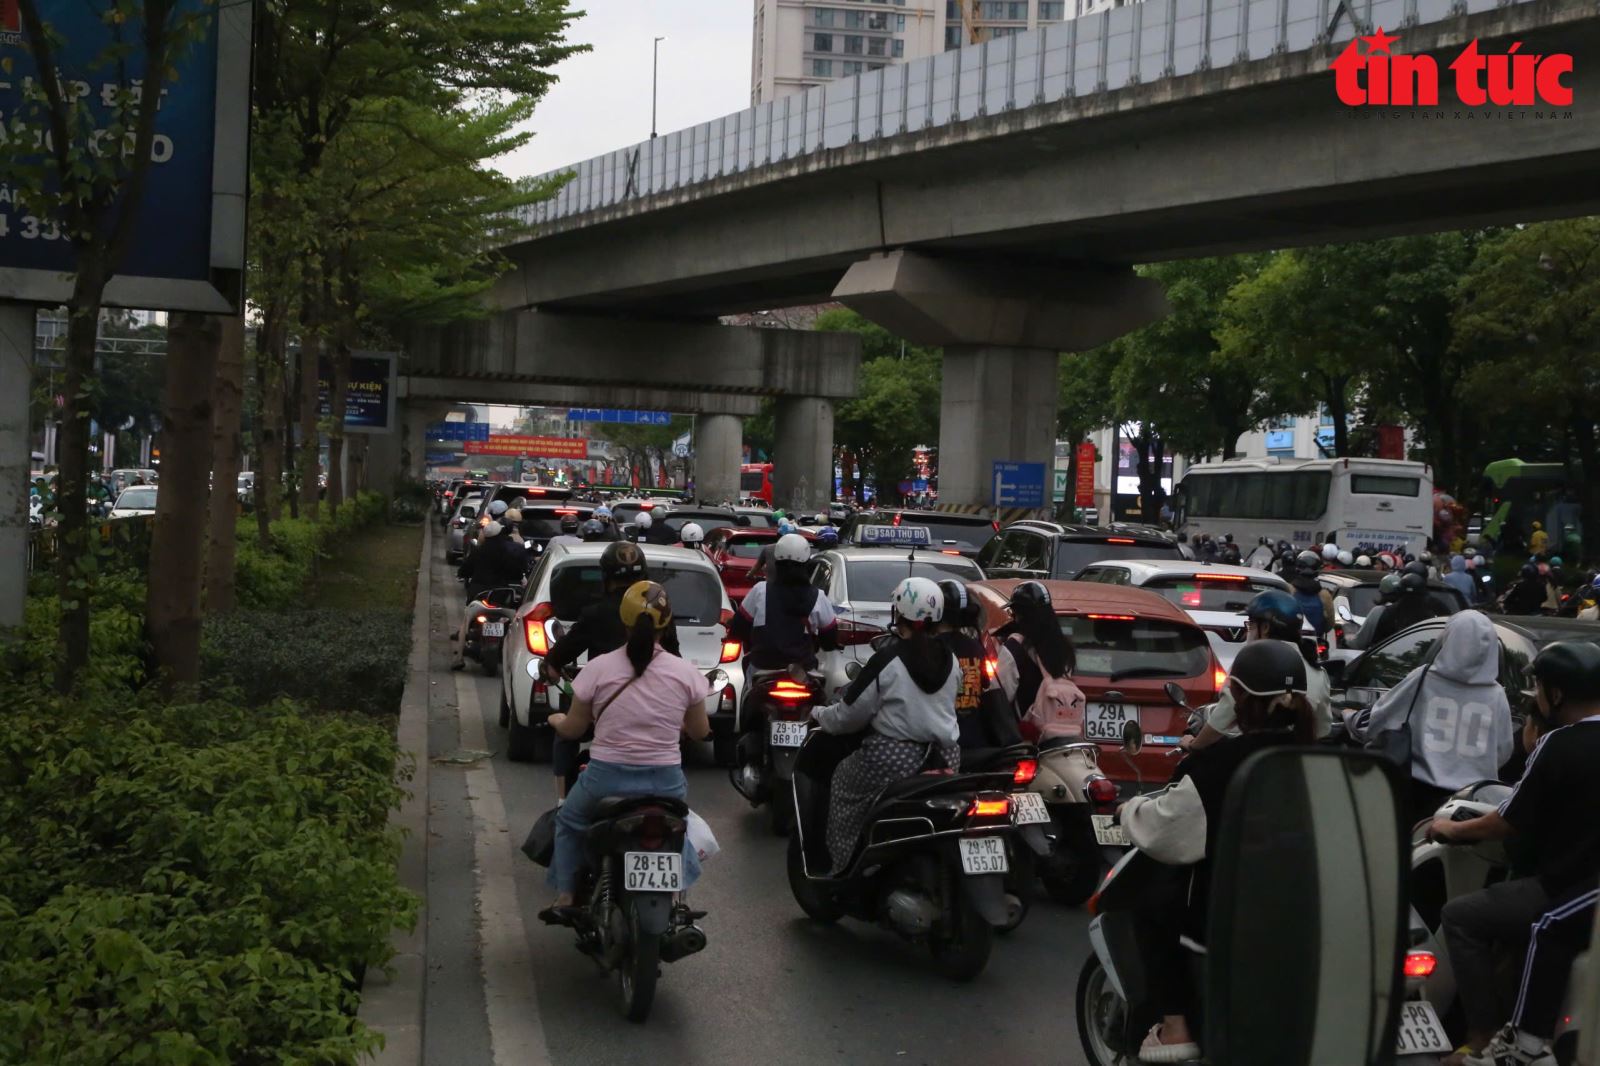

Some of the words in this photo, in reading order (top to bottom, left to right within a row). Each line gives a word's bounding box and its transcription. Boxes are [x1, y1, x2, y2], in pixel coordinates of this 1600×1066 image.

[1098, 703, 1126, 720] 29A
[1424, 696, 1493, 757] 90
[966, 839, 999, 855] 29-H2
[633, 855, 672, 871] 28-E1
[966, 855, 1004, 871] 155.07
[629, 872, 678, 888] 074.48
